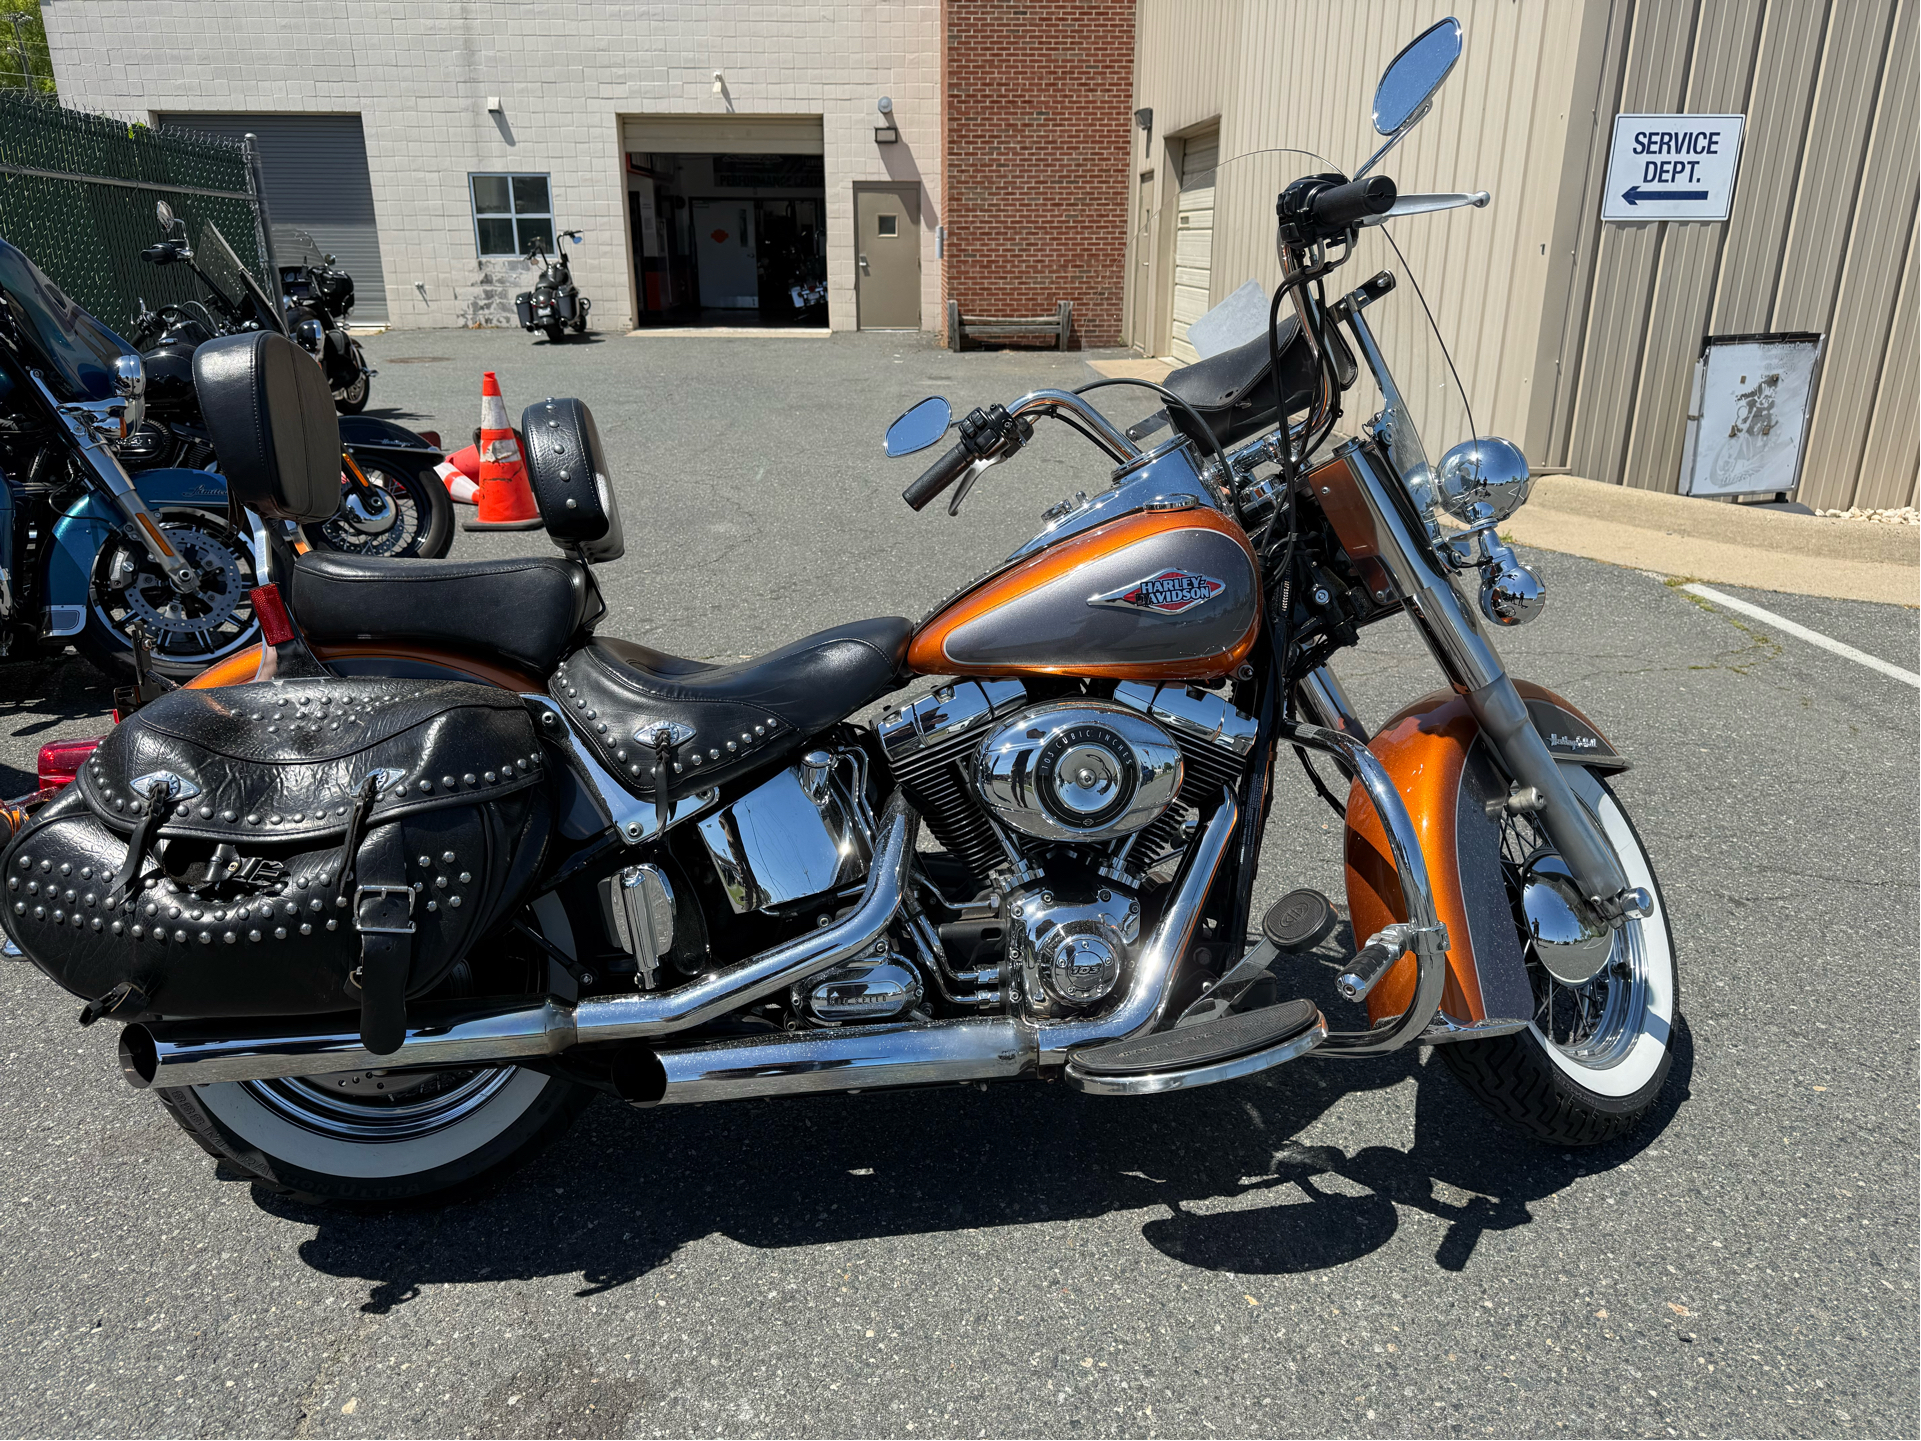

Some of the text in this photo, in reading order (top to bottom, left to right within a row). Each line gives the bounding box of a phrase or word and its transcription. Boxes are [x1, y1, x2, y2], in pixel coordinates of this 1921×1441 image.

[1633, 132, 1720, 154] SERVICE
[1643, 161, 1701, 183] DEPT.
[1141, 576, 1207, 594] HARLEY-
[1136, 586, 1211, 606] DAVIDSON
[1056, 729, 1091, 749] CUBIC
[1098, 731, 1133, 766] INCHES
[1071, 965, 1101, 976] 103
